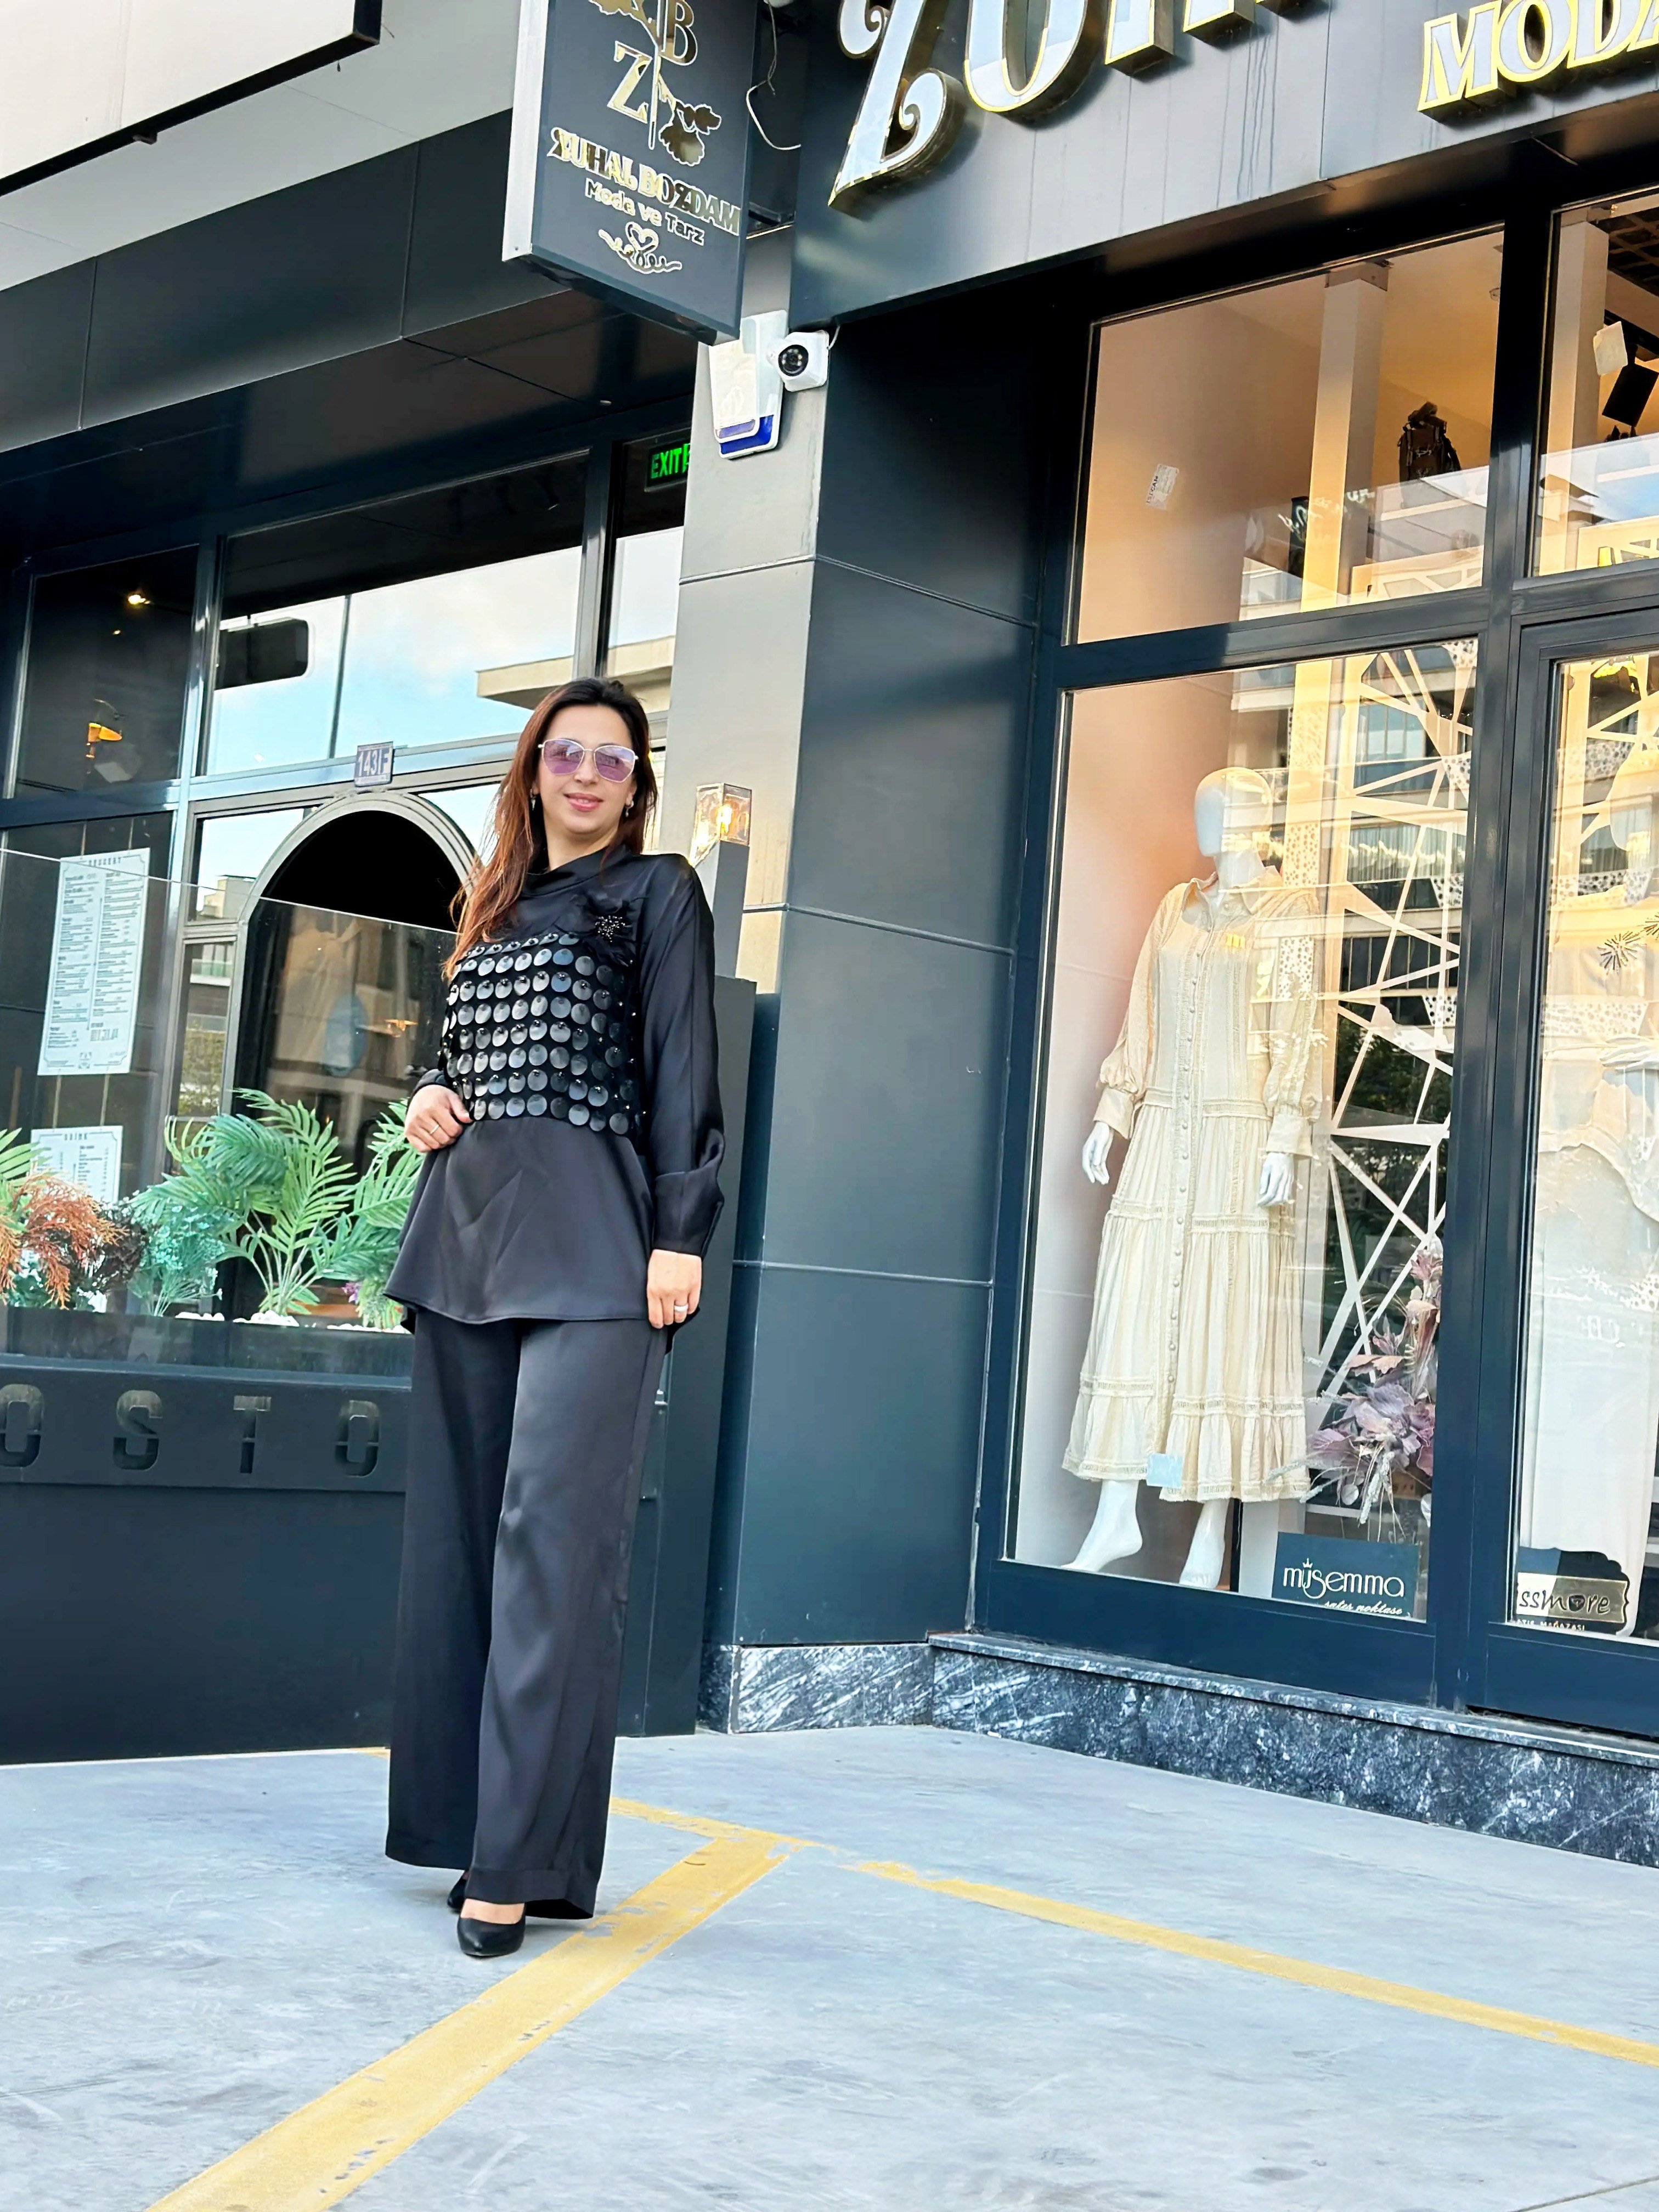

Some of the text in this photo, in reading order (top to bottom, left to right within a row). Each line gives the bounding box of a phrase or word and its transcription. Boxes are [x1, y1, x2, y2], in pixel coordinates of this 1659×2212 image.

[607, 41, 652, 124] Z
[585, 178, 705, 246] Moda ve Tarz
[651, 447, 682, 479] EXIT
